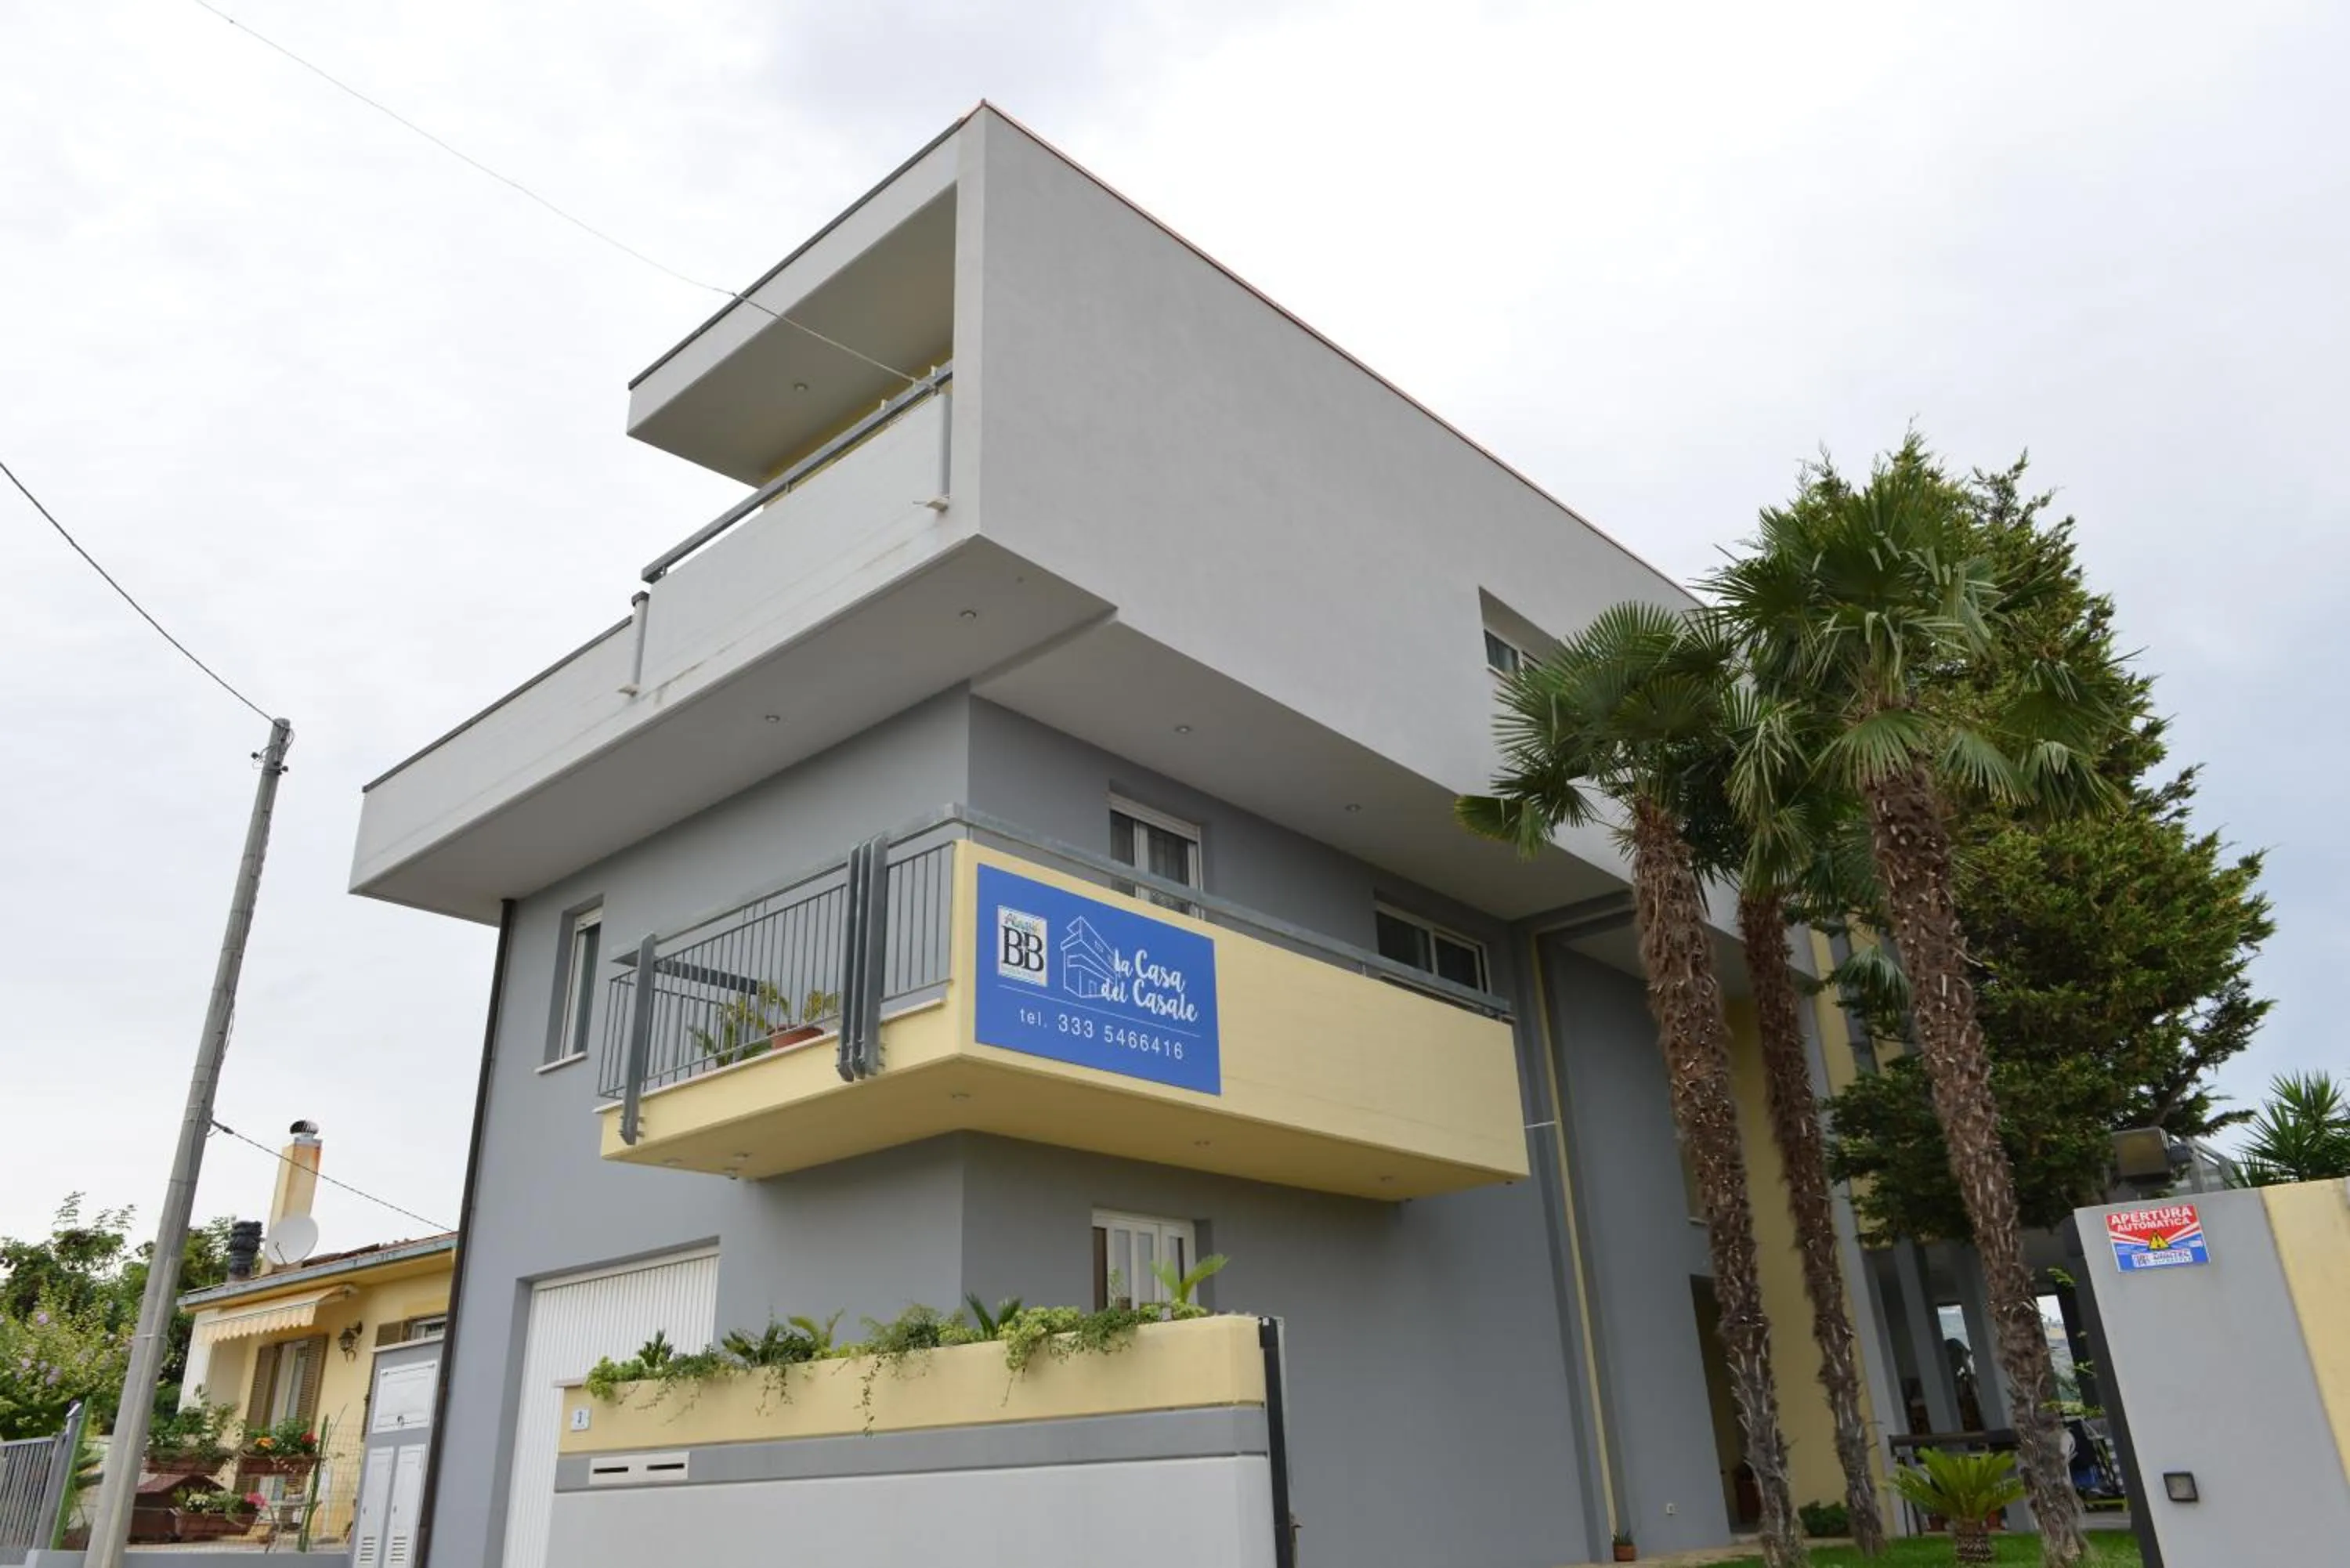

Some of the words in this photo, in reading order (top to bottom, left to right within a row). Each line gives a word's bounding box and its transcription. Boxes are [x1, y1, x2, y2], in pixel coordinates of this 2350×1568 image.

[1135, 949, 1186, 992] Casa
[1101, 977, 1128, 1003] del
[1133, 978, 1198, 1022] Casale
[1020, 1008, 1047, 1028] tel.
[1058, 1013, 1094, 1039] 333
[1104, 1024, 1184, 1060] 5466416
[2111, 1205, 2193, 1226] APERTURA
[2117, 1217, 2191, 1232] AUTOMATICA
